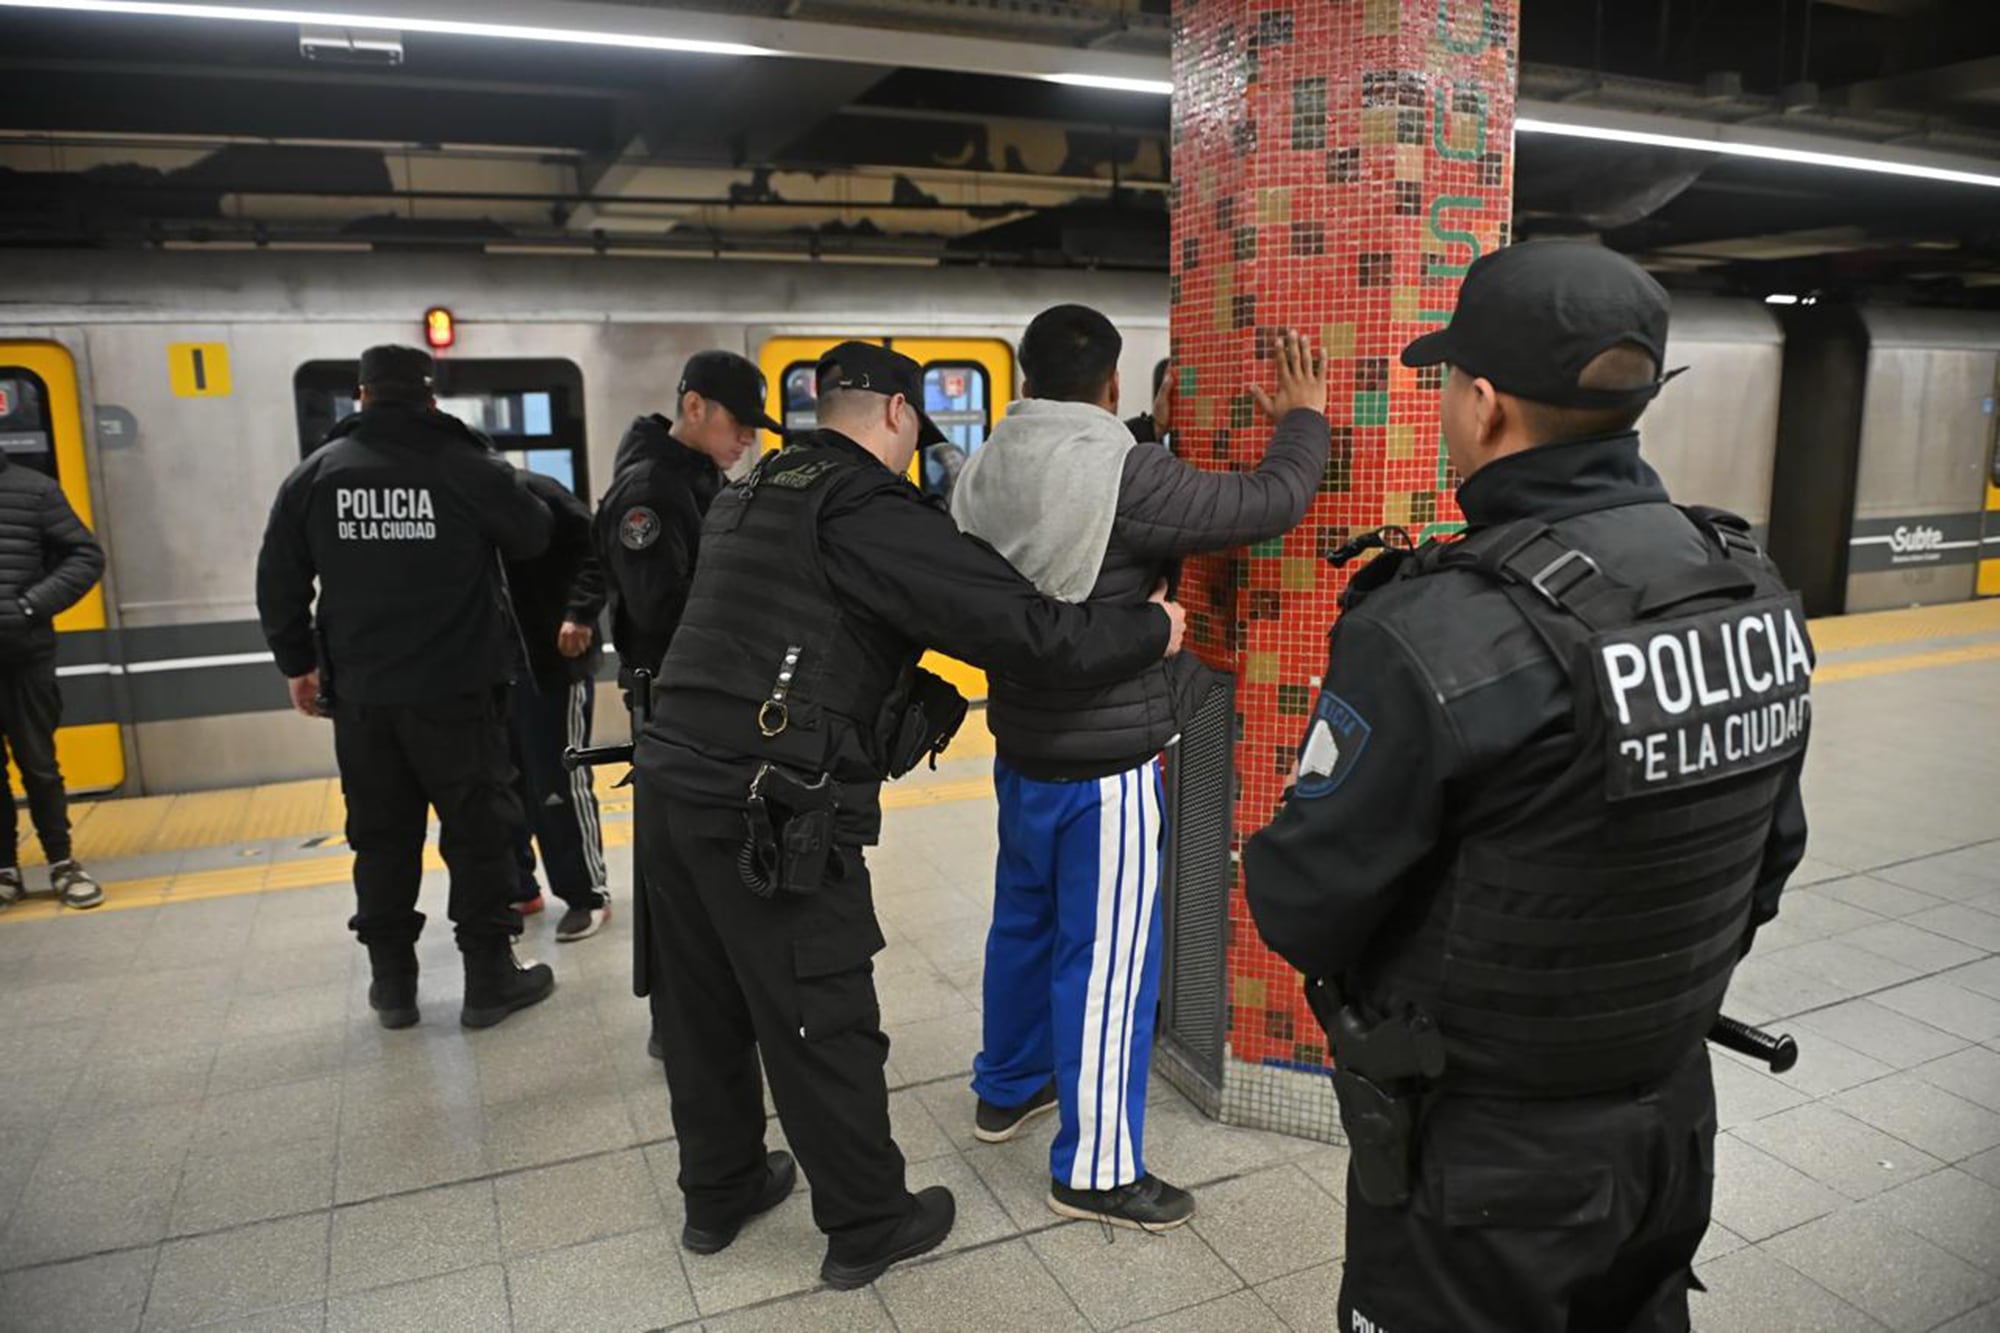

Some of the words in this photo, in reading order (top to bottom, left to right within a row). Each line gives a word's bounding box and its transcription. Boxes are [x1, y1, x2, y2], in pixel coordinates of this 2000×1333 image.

[336, 488, 435, 519] POLICIA
[338, 521, 358, 539] DE
[360, 521, 379, 539] LA
[381, 521, 436, 540] CIUDAD
[1890, 525, 1944, 552] Subte
[1602, 609, 1812, 725] POLICIA
[1677, 722, 1719, 775] LA
